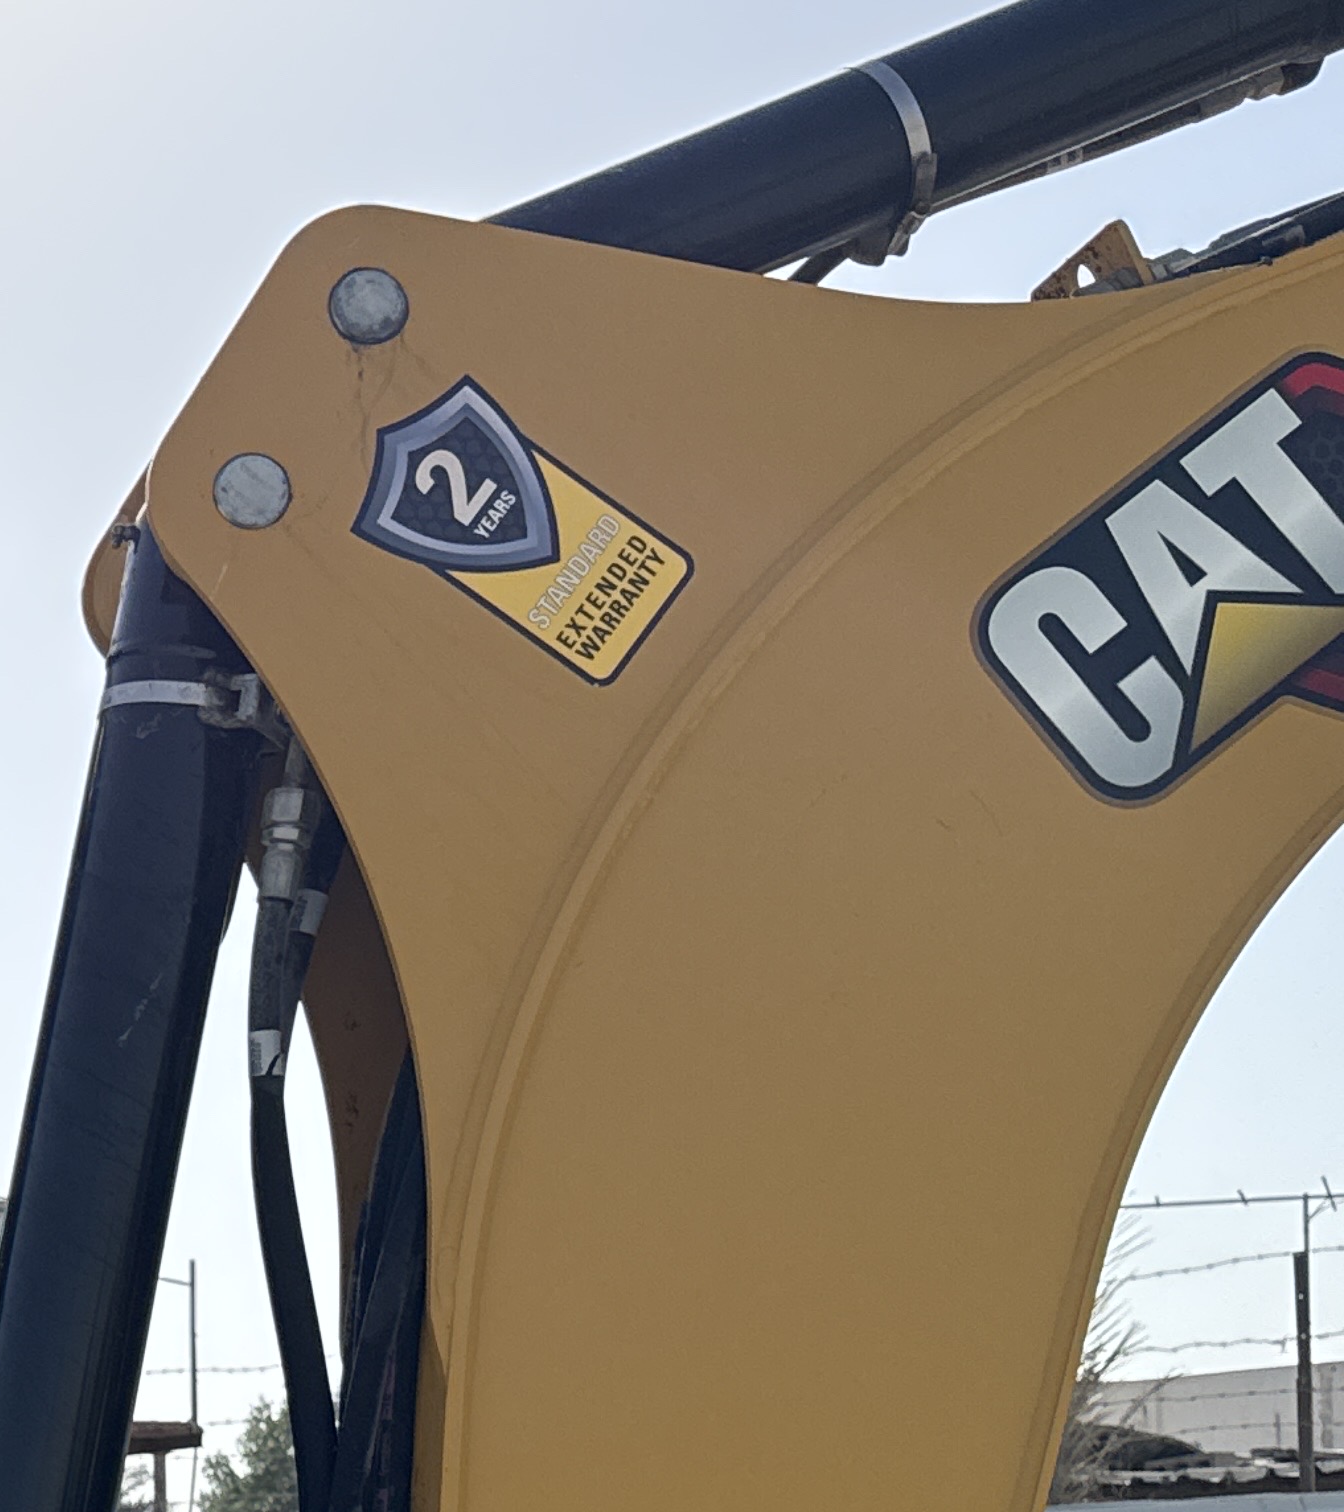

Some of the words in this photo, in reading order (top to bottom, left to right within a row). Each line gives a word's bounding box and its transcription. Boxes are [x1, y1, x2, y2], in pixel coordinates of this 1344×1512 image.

[415, 448, 498, 527] 2
[473, 489, 516, 540] YEARS
[527, 513, 621, 630] STANDARD
[555, 535, 648, 651] EXTENDED
[574, 547, 666, 661] WARRANTY
[988, 387, 1344, 787] CAT
